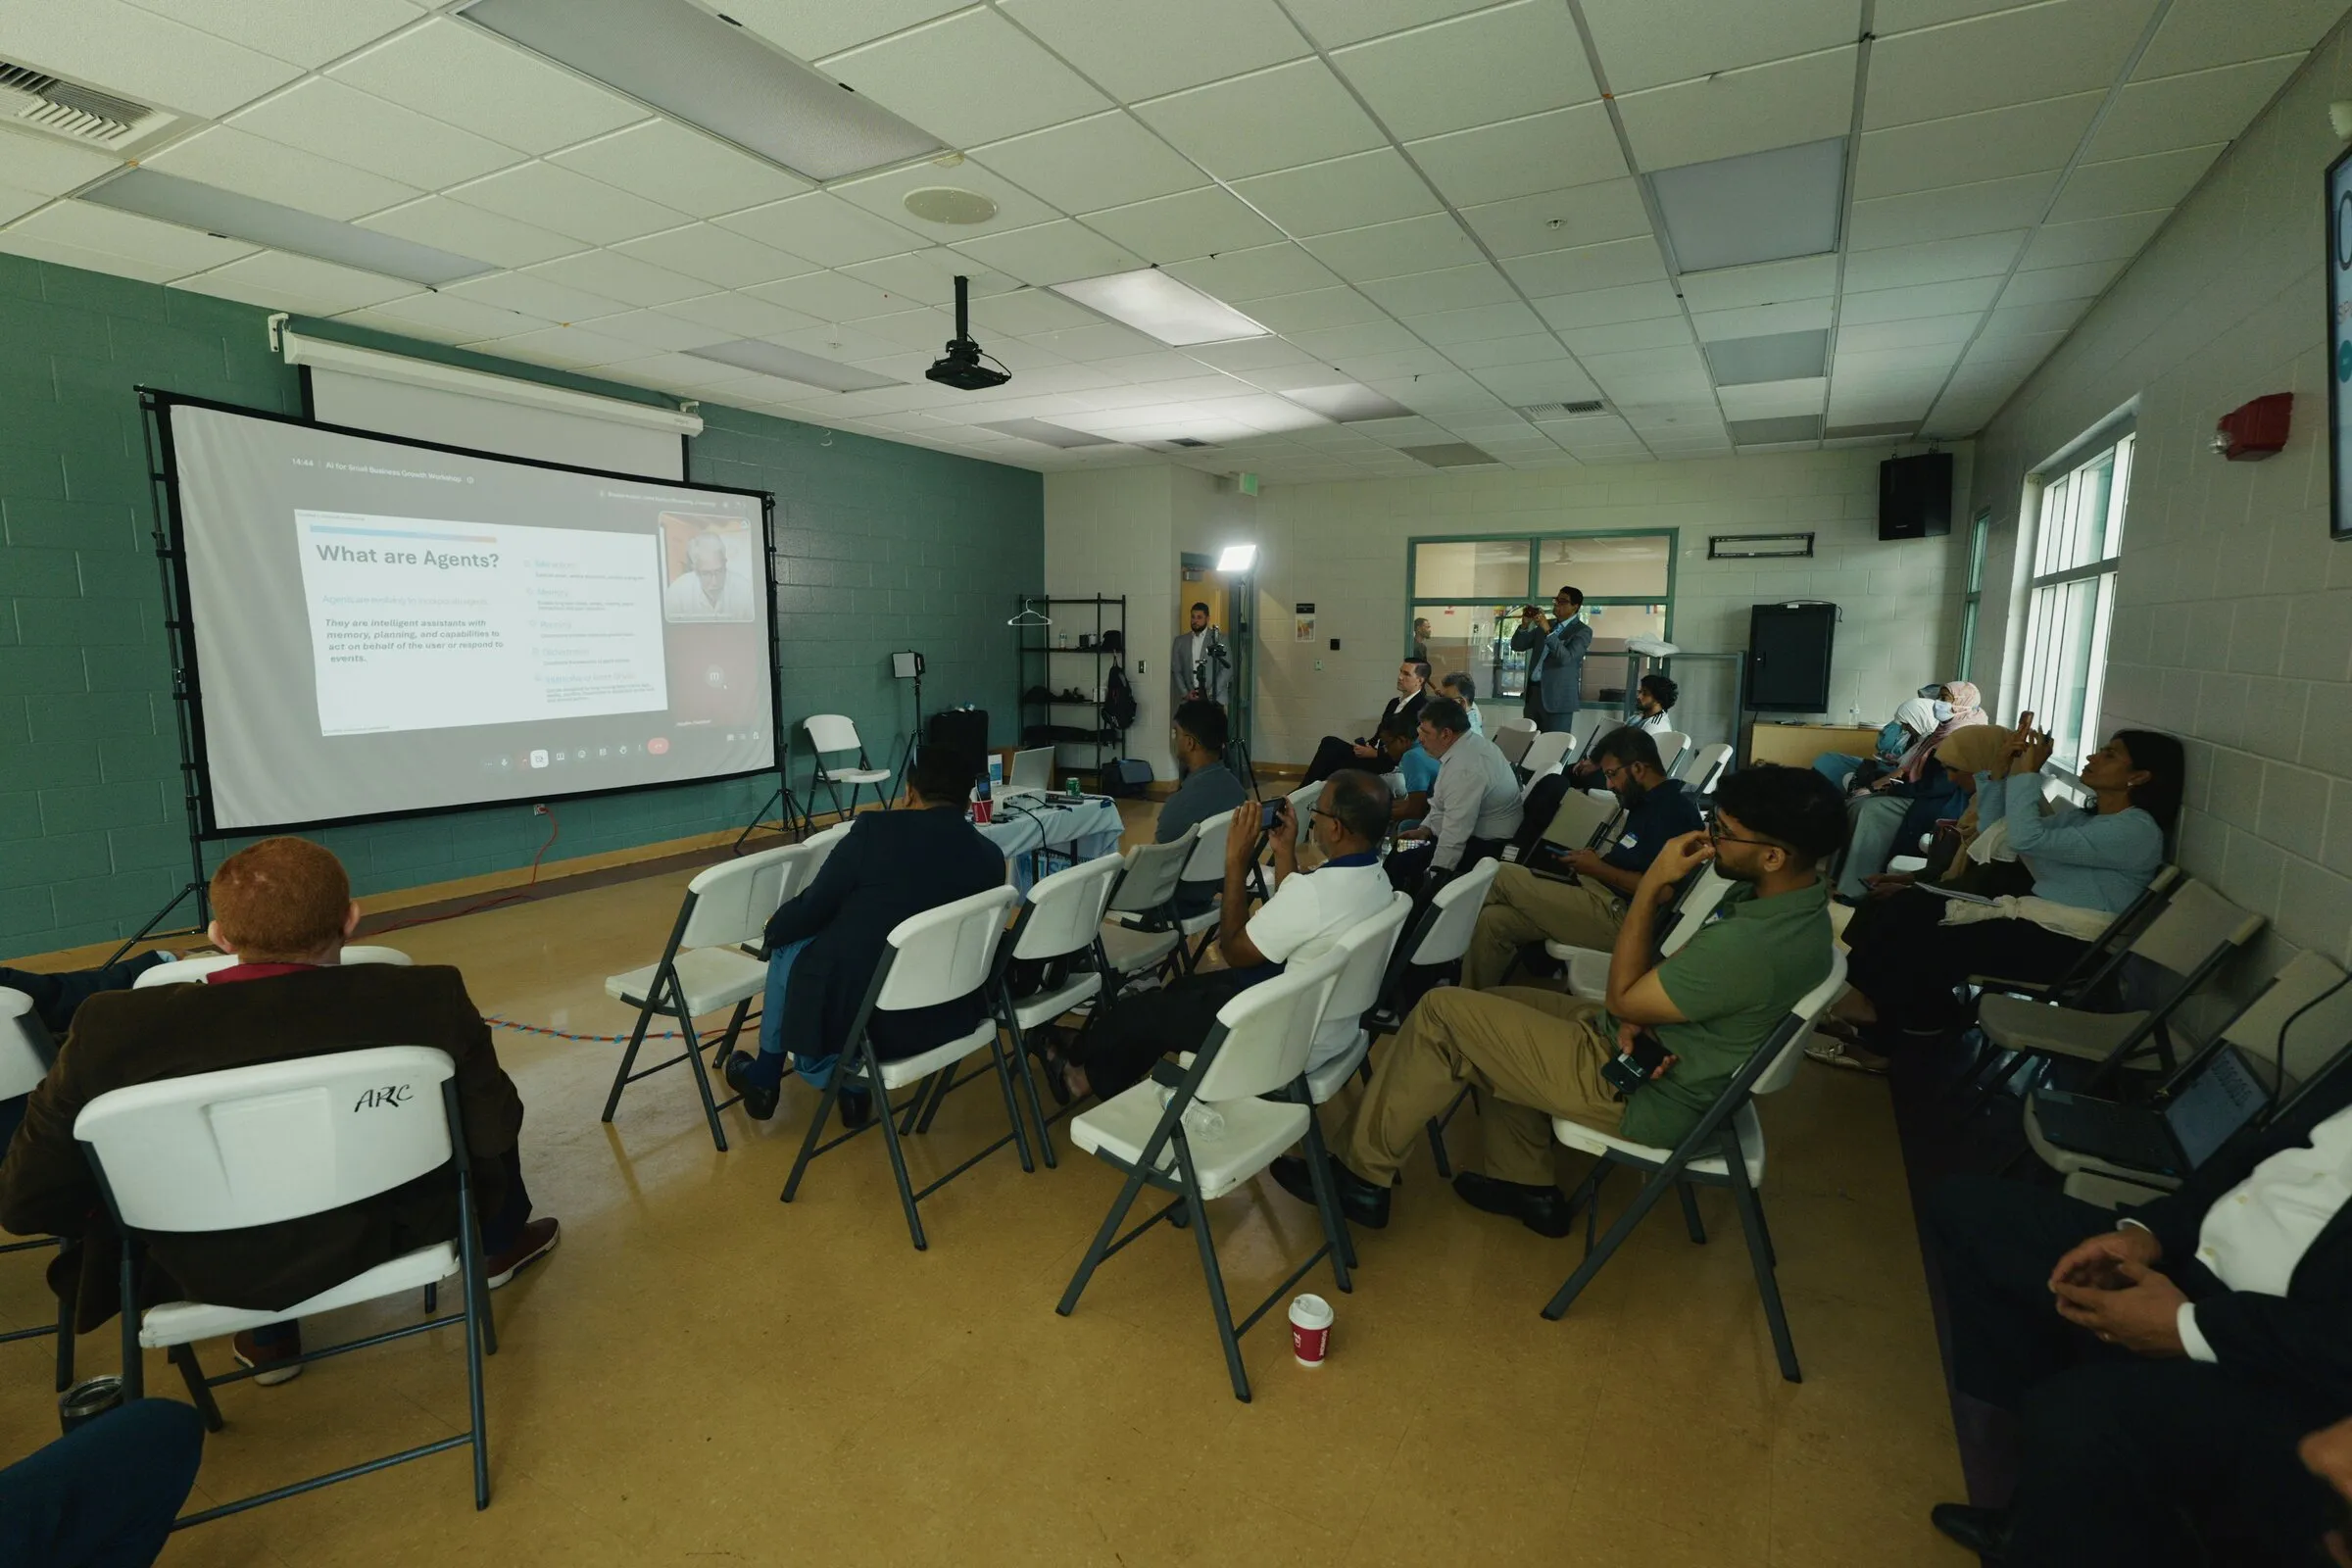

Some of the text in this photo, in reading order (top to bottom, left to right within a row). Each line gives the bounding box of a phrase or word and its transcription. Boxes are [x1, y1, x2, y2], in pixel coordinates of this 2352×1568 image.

[348, 464, 368, 472] Small
[368, 466, 401, 476] Business
[401, 469, 427, 479] Growth
[427, 472, 463, 483] Workshop
[316, 544, 500, 569] What are Agents?
[325, 618, 350, 628] They
[370, 618, 418, 628] intelligent
[467, 618, 486, 627] with
[326, 631, 371, 640] memory,
[373, 630, 417, 640] planning,
[439, 629, 489, 639] capabilities
[408, 641, 423, 650] the
[459, 640, 493, 650] respond
[330, 654, 367, 662] events.
[354, 1084, 414, 1112] ARC
